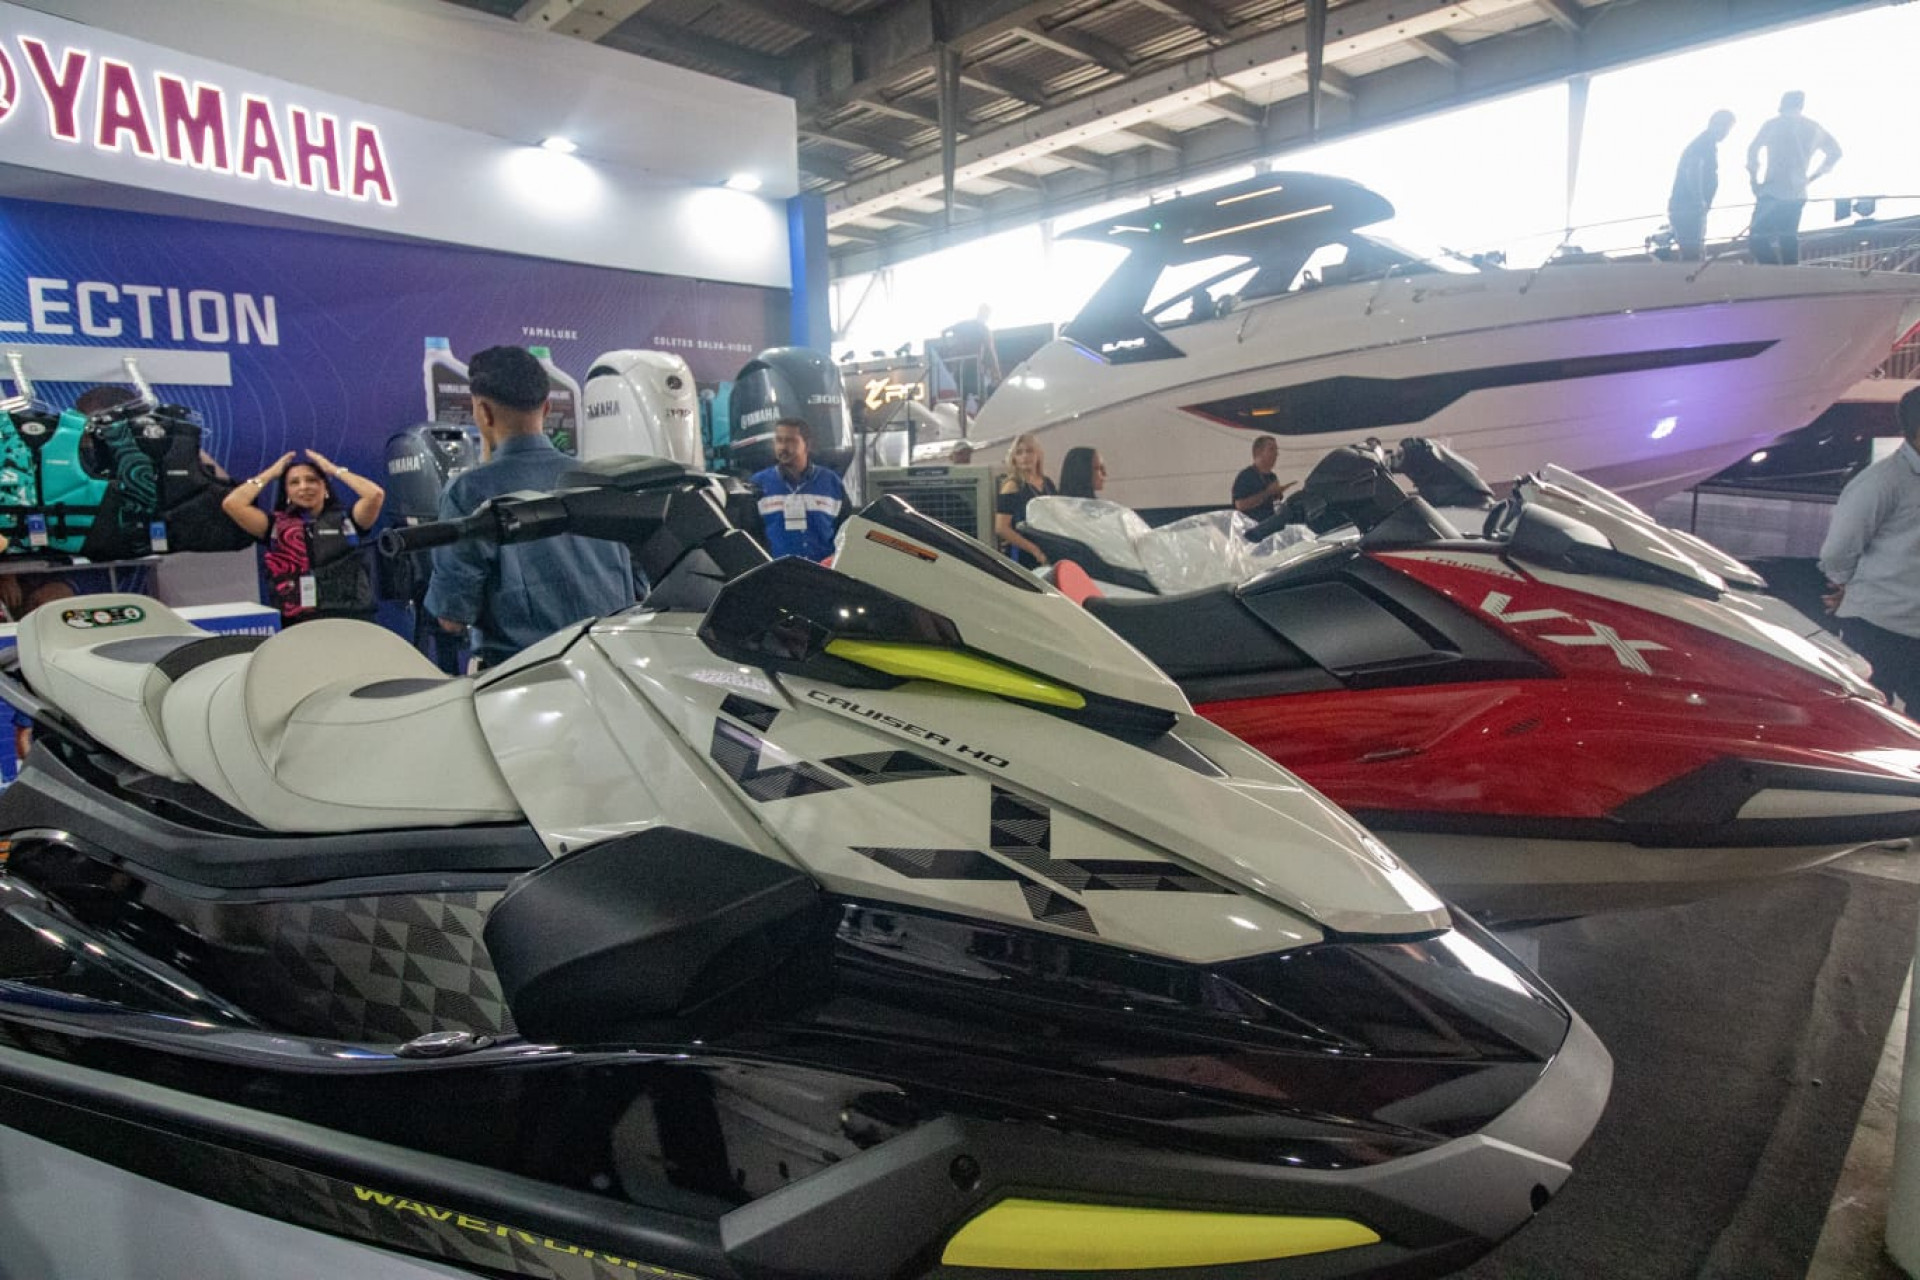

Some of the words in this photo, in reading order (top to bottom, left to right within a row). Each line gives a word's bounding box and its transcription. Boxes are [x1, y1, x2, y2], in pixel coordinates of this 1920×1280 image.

[20, 36, 396, 204] YAMAHA
[521, 326, 578, 340] YAMALUBE
[653, 336, 693, 348] COLETES
[1479, 591, 1674, 676] VX
[807, 688, 950, 747] CRUISER
[956, 742, 1011, 768] HO
